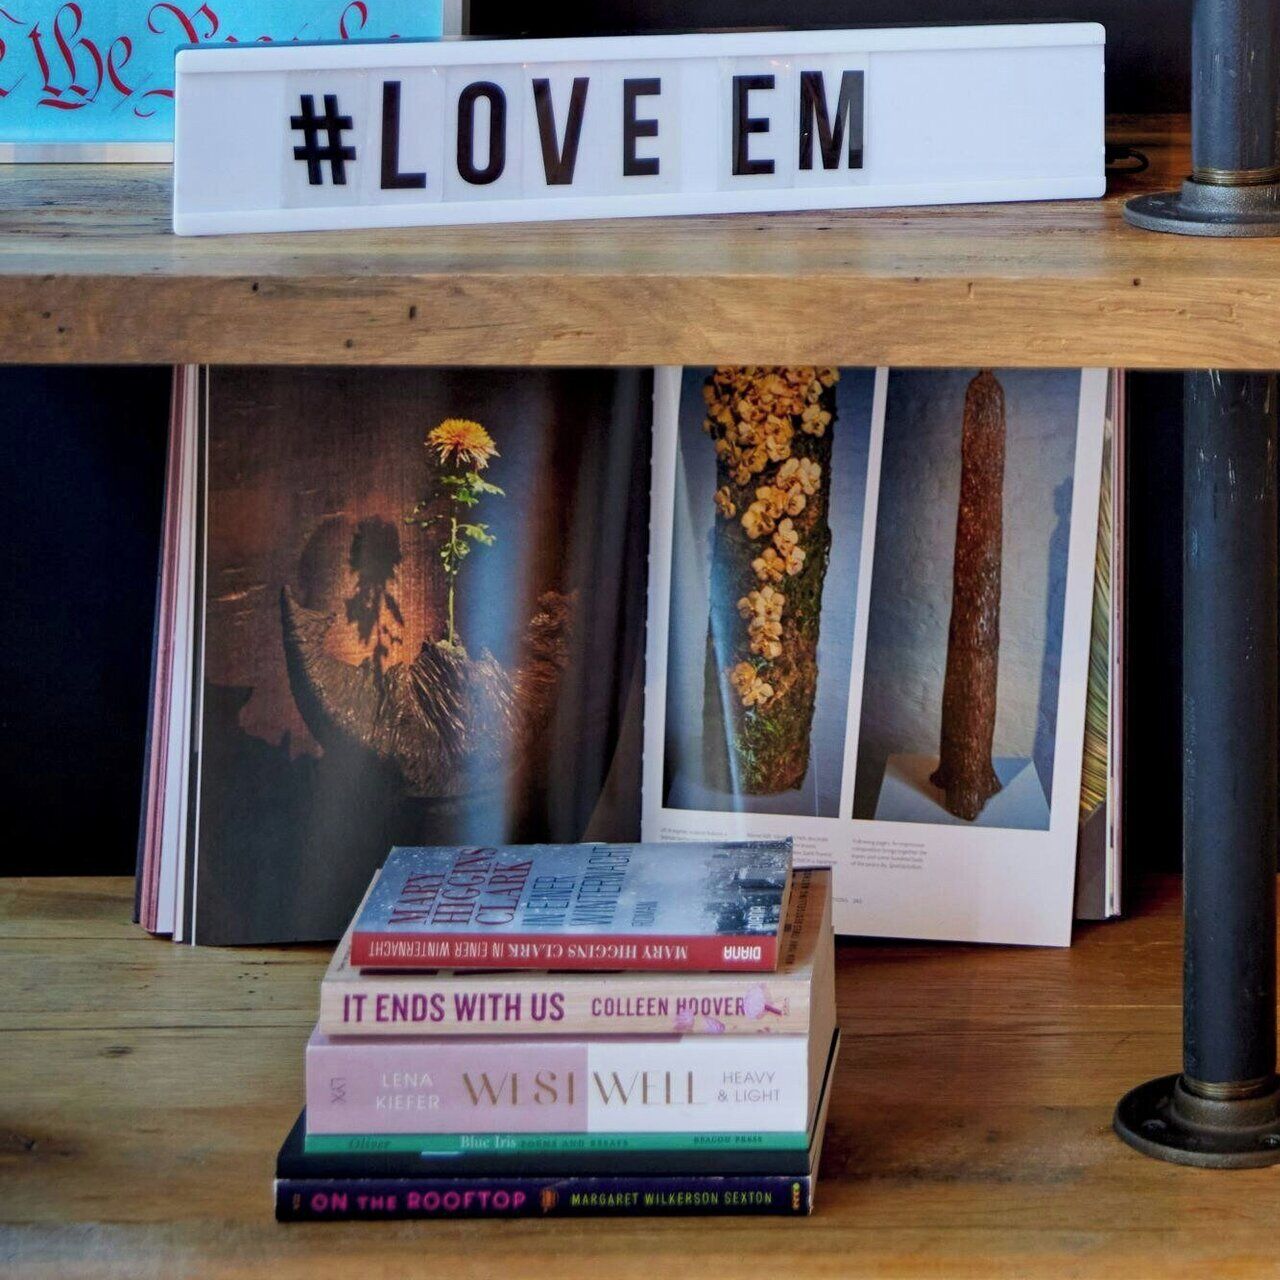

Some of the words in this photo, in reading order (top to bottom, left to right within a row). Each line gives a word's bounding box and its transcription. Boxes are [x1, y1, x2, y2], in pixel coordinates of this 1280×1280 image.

[289, 76, 661, 191] #LOVE
[732, 69, 865, 177] EM
[430, 847, 498, 926] HIGGINS
[474, 859, 534, 926] CLARK
[387, 872, 446, 926] MARY
[369, 940, 450, 958] WINTERNACHT
[454, 941, 488, 959] EINER
[491, 942, 504, 959] IN
[507, 943, 564, 960] CLARK
[567, 944, 639, 960] HIGGINS
[641, 944, 689, 960] MARY
[723, 945, 762, 960] DIANA
[343, 993, 368, 1023] IT
[375, 993, 446, 1023] ENDS
[454, 992, 522, 1022] WITH
[530, 992, 565, 1022] US
[591, 996, 669, 1017] COLLEEN
[675, 996, 746, 1017] HOOVER
[382, 1072, 434, 1089] LENA
[723, 1071, 776, 1085] HEAVY
[375, 1094, 440, 1111] KIEFER
[717, 1089, 729, 1102] &
[735, 1089, 781, 1103] LIGHT
[460, 1135, 490, 1149] Blue
[494, 1135, 517, 1149] Iris
[310, 1193, 349, 1211] ON
[357, 1194, 398, 1211] THE
[406, 1191, 527, 1210] ROOFTOP
[570, 1192, 639, 1208] MARGARET
[643, 1191, 719, 1207] WILKERSON
[723, 1190, 773, 1205] SEXTON
